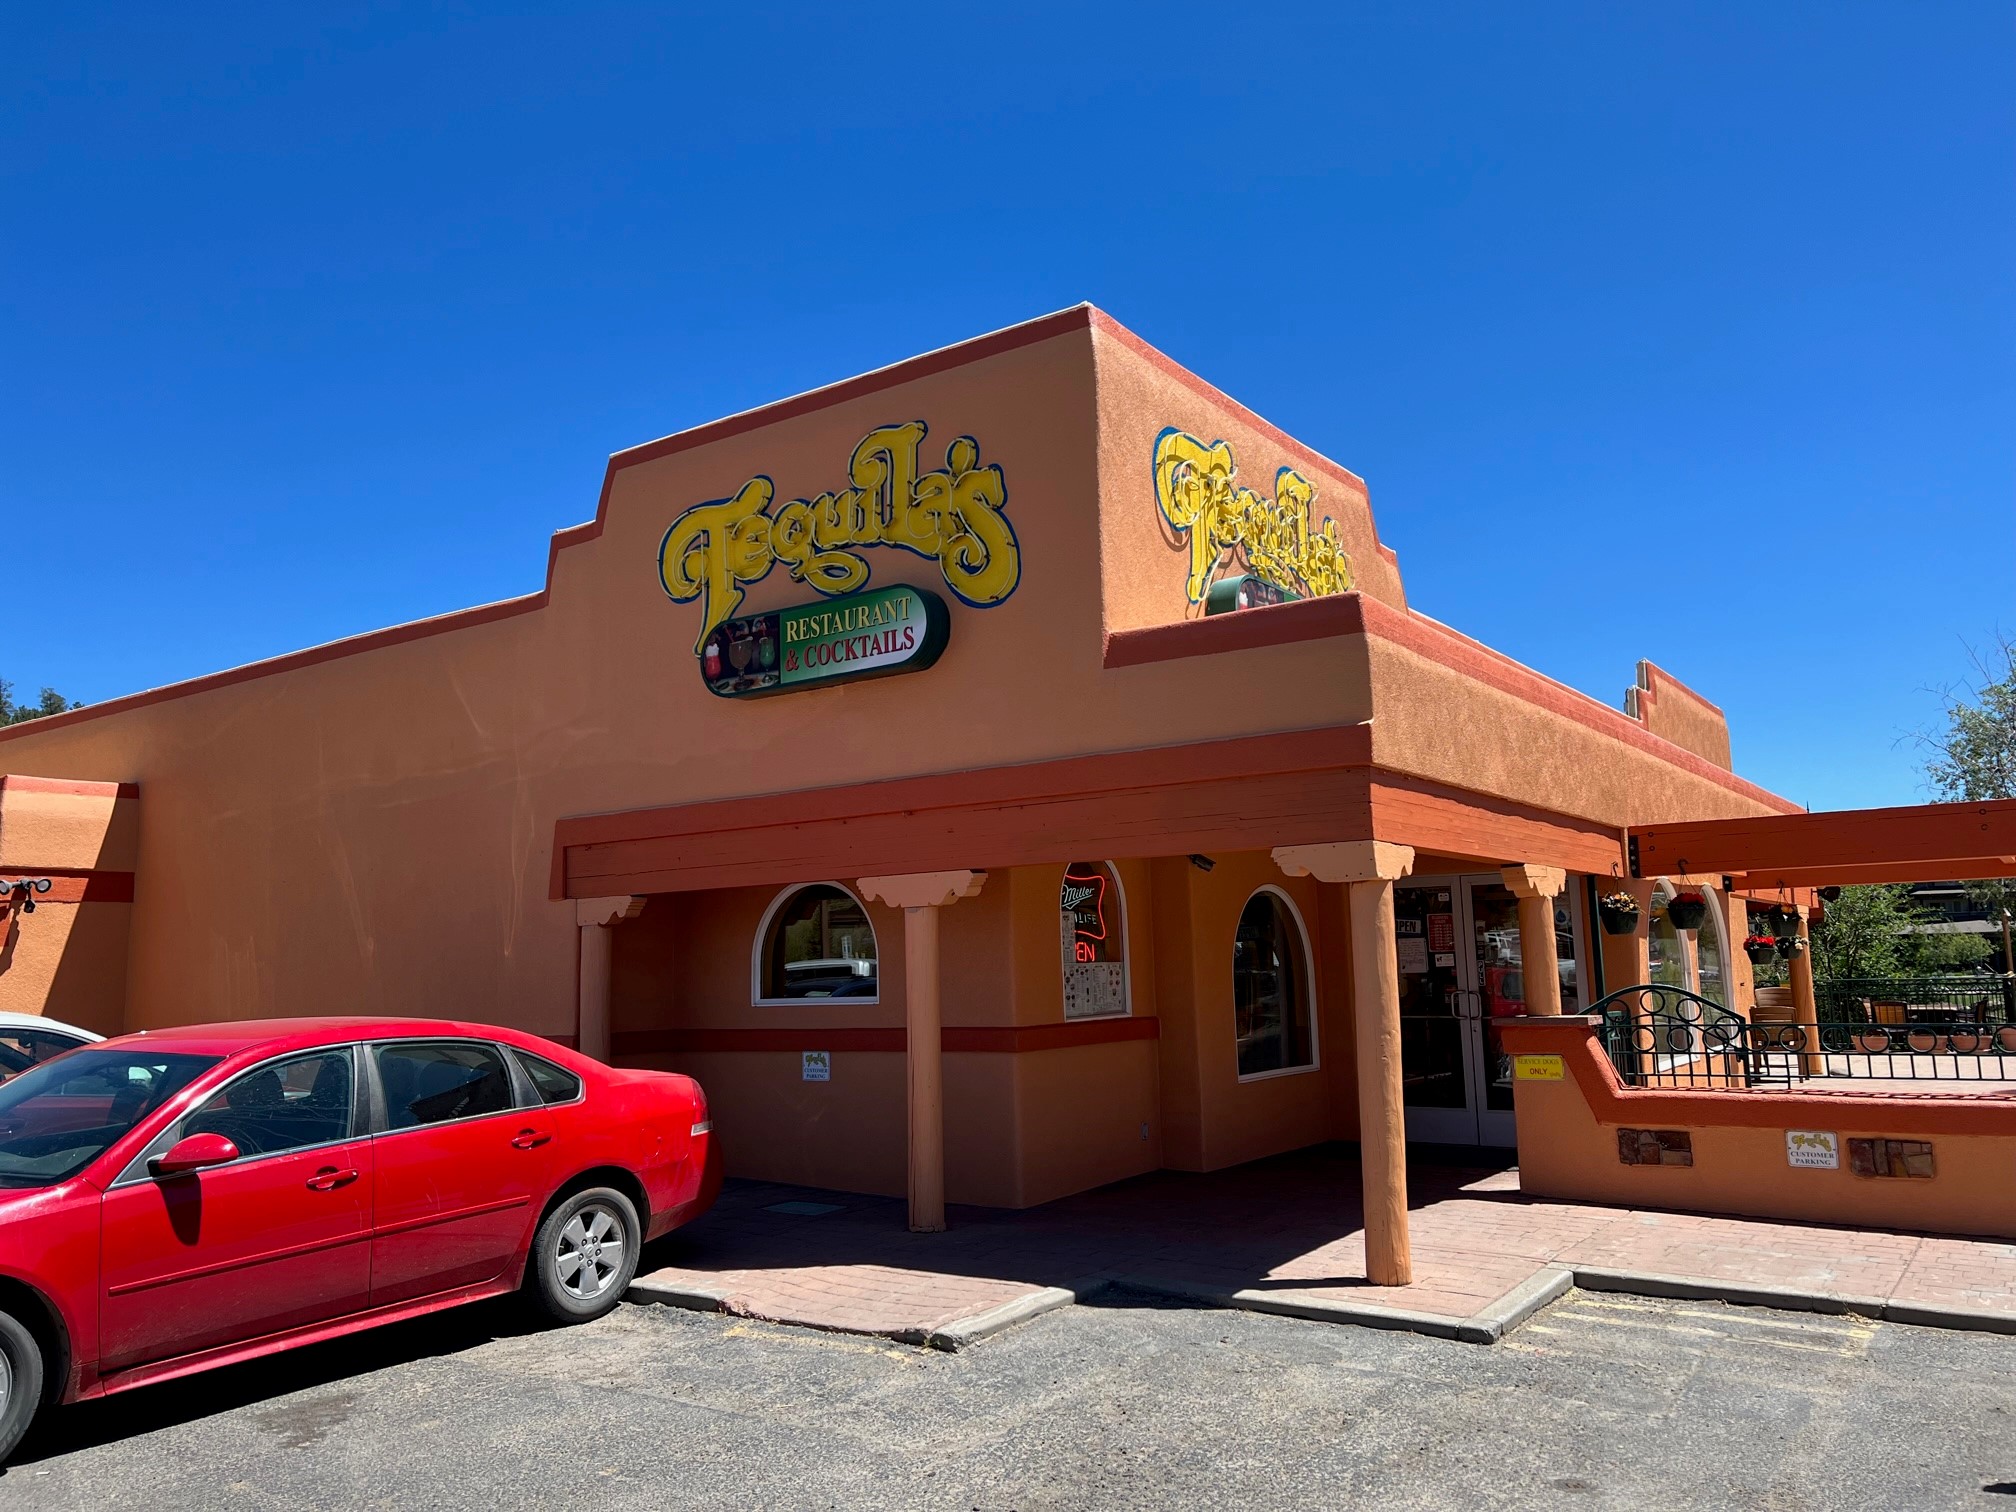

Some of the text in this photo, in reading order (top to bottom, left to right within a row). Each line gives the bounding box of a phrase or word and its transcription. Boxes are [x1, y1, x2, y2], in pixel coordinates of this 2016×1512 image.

[786, 596, 912, 642] RESTAURANT
[785, 626, 915, 672] & COCKTAILS
[1062, 884, 1095, 904] Miller
[1079, 911, 1098, 925] LIFE
[1074, 942, 1095, 962] EN
